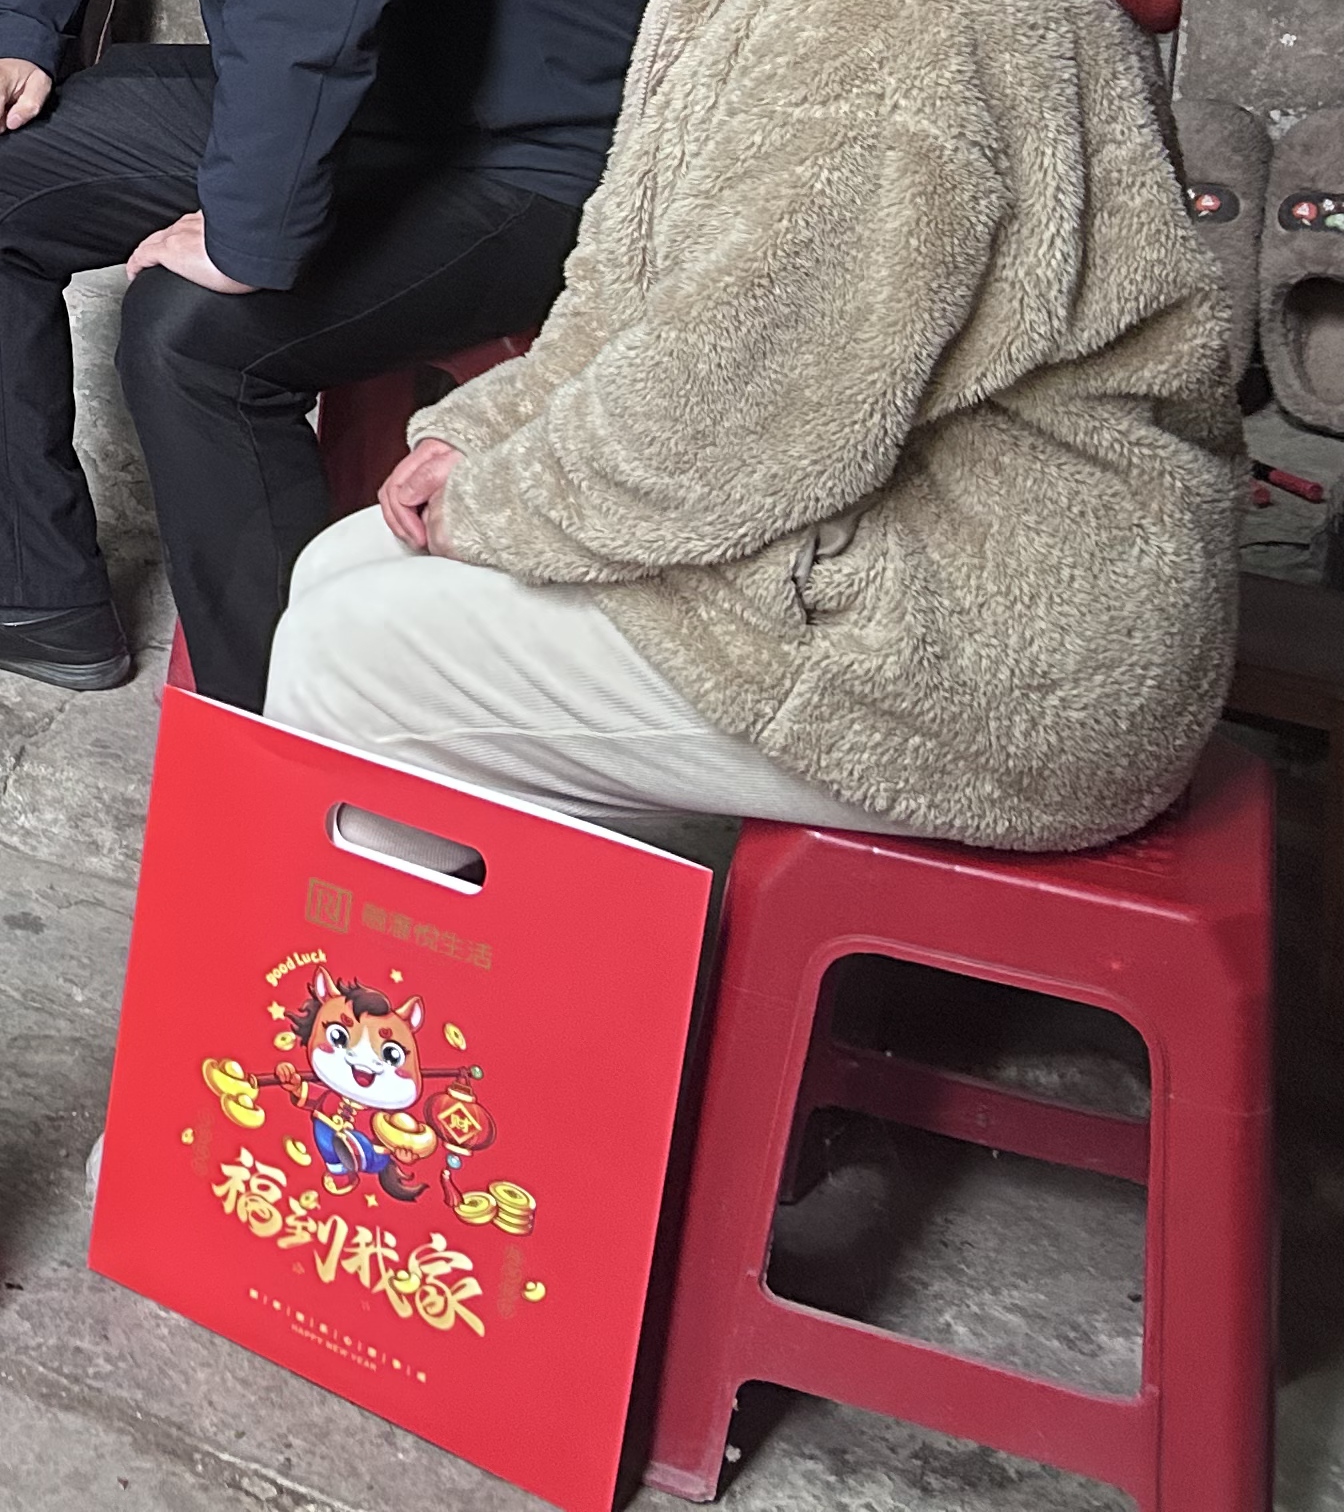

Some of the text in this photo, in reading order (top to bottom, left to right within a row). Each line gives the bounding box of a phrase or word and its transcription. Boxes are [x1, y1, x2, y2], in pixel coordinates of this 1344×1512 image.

[266, 948, 327, 987] good Luck
[212, 1147, 485, 1338] 福到我家
